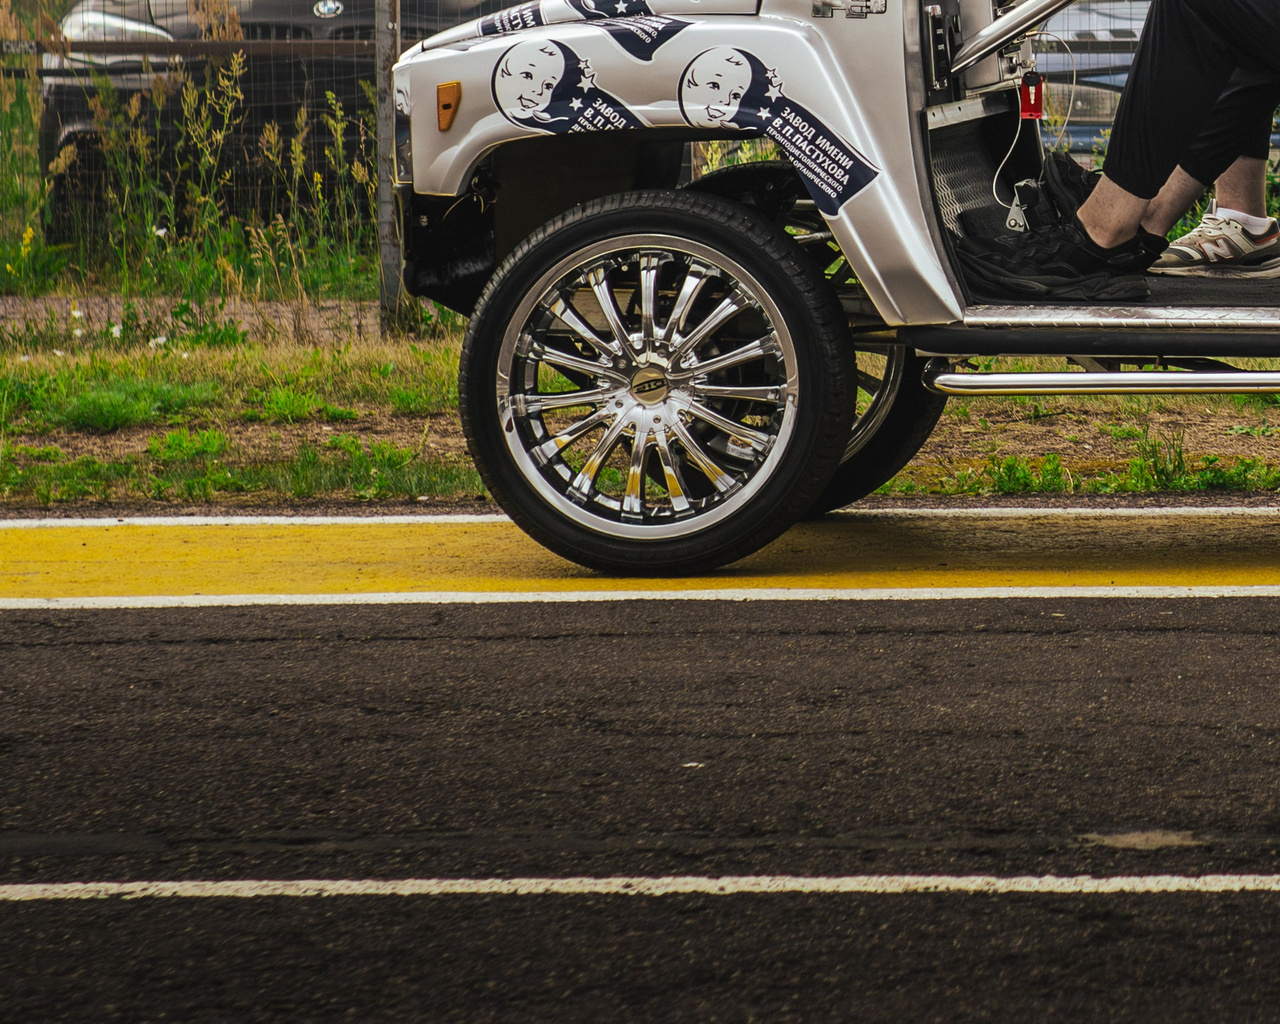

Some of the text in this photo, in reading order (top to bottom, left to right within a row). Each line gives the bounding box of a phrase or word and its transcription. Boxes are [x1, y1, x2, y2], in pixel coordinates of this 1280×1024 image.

[583, 107, 595, 121] В.
[592, 97, 627, 130] ЗАВОД
[771, 117, 783, 131] В.
[781, 125, 794, 139] П.
[791, 133, 850, 185] ПАСТУХОВА
[780, 106, 816, 141] ЗАВОД
[815, 135, 854, 170] ИМЕНИ
[792, 159, 837, 199] ОРГАНИЧЕСКОГО
